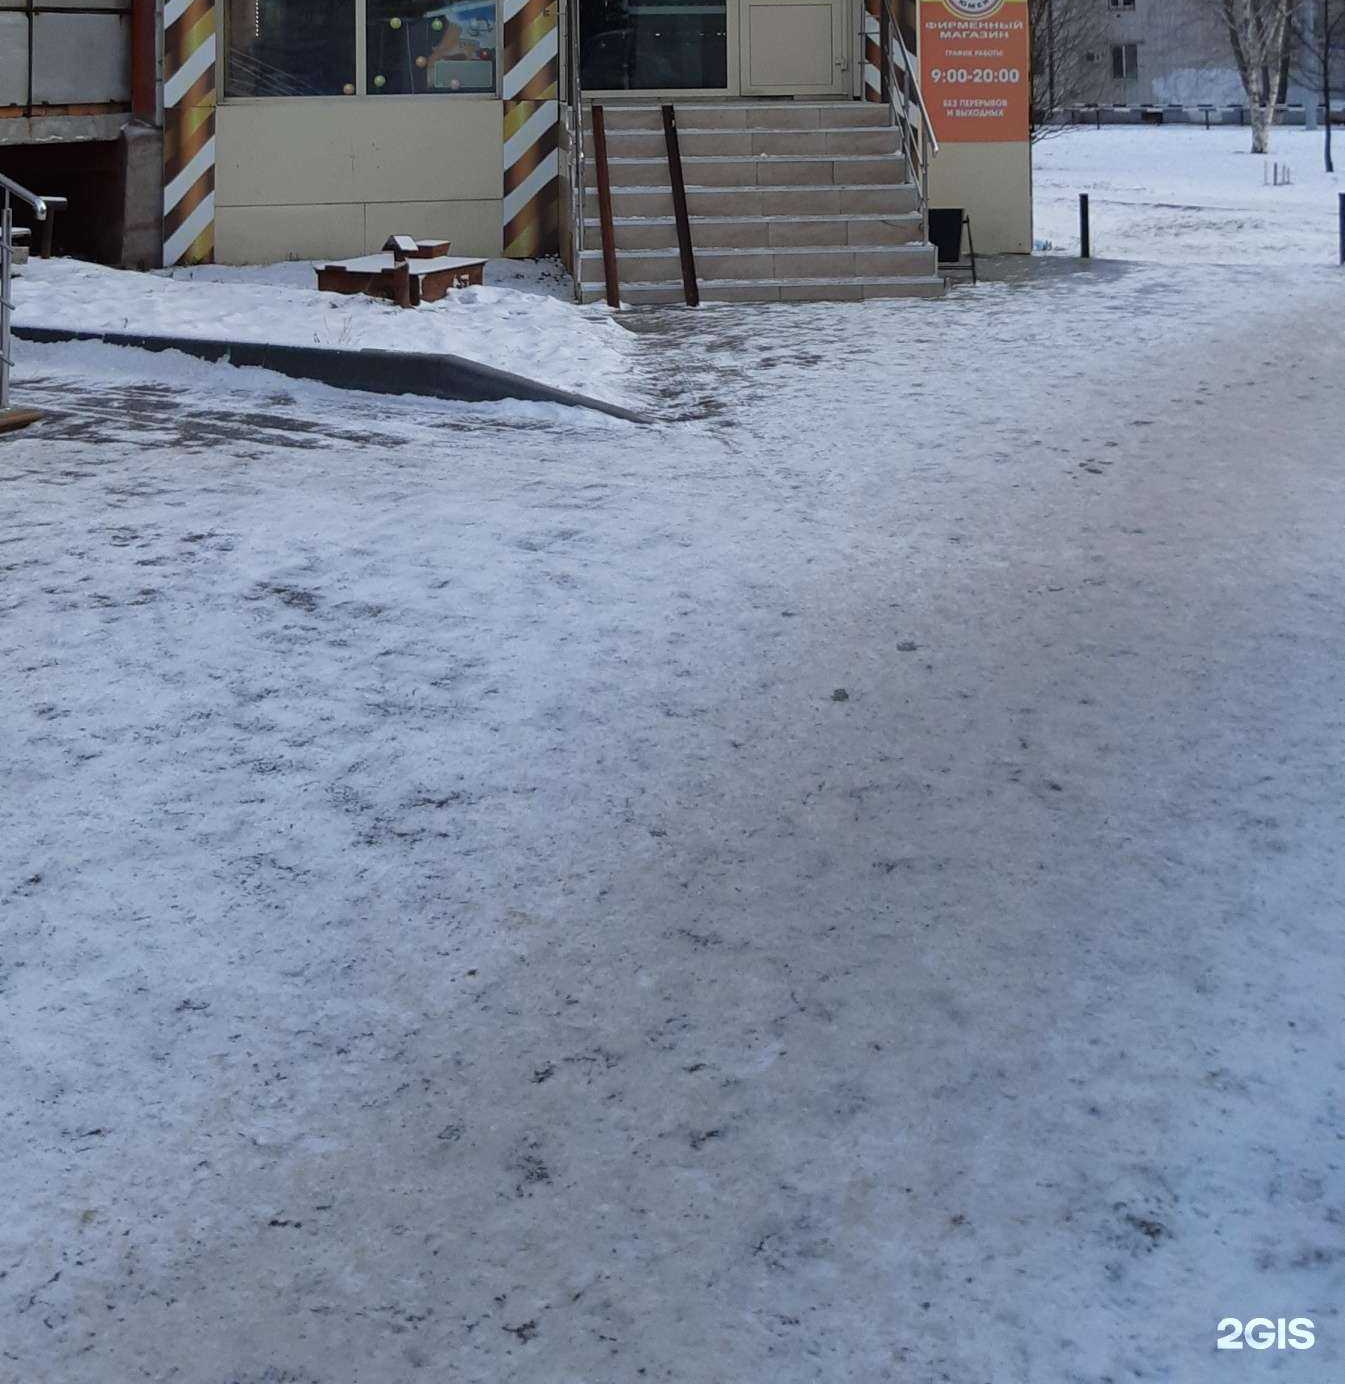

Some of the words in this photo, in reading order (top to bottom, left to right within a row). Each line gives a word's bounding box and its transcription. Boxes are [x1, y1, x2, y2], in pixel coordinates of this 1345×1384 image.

[925, 20, 1024, 30] ФИРМЕННЫЙ
[939, 31, 1010, 39] МАГАЗИН
[931, 68, 1020, 83] 9:00-20:00
[943, 99, 958, 107] БЕЗ
[959, 99, 1008, 107] ПЕРЕРЫВОВ
[955, 108, 1004, 117] ВЫХОДНЫХ
